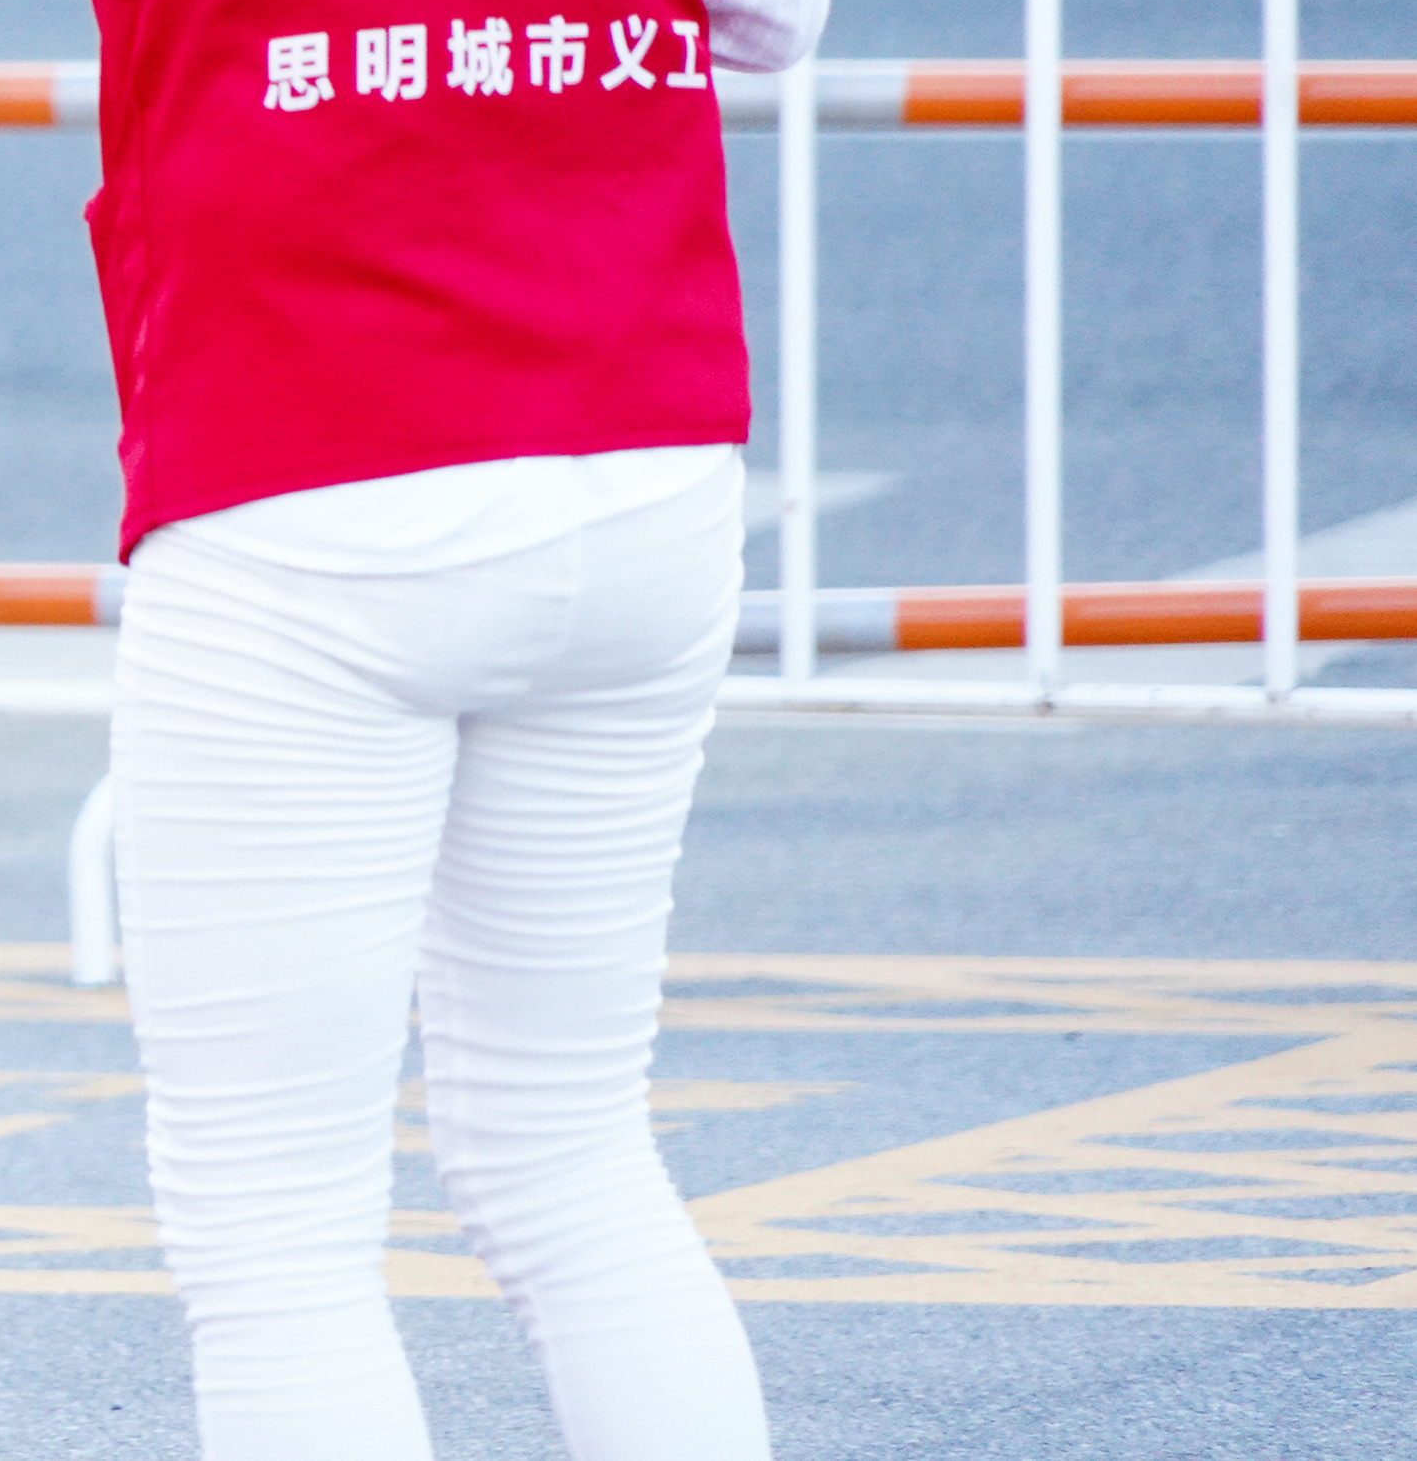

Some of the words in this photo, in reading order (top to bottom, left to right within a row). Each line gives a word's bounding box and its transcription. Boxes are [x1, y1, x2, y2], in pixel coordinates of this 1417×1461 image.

[263, 14, 708, 112] 思明城市义工
